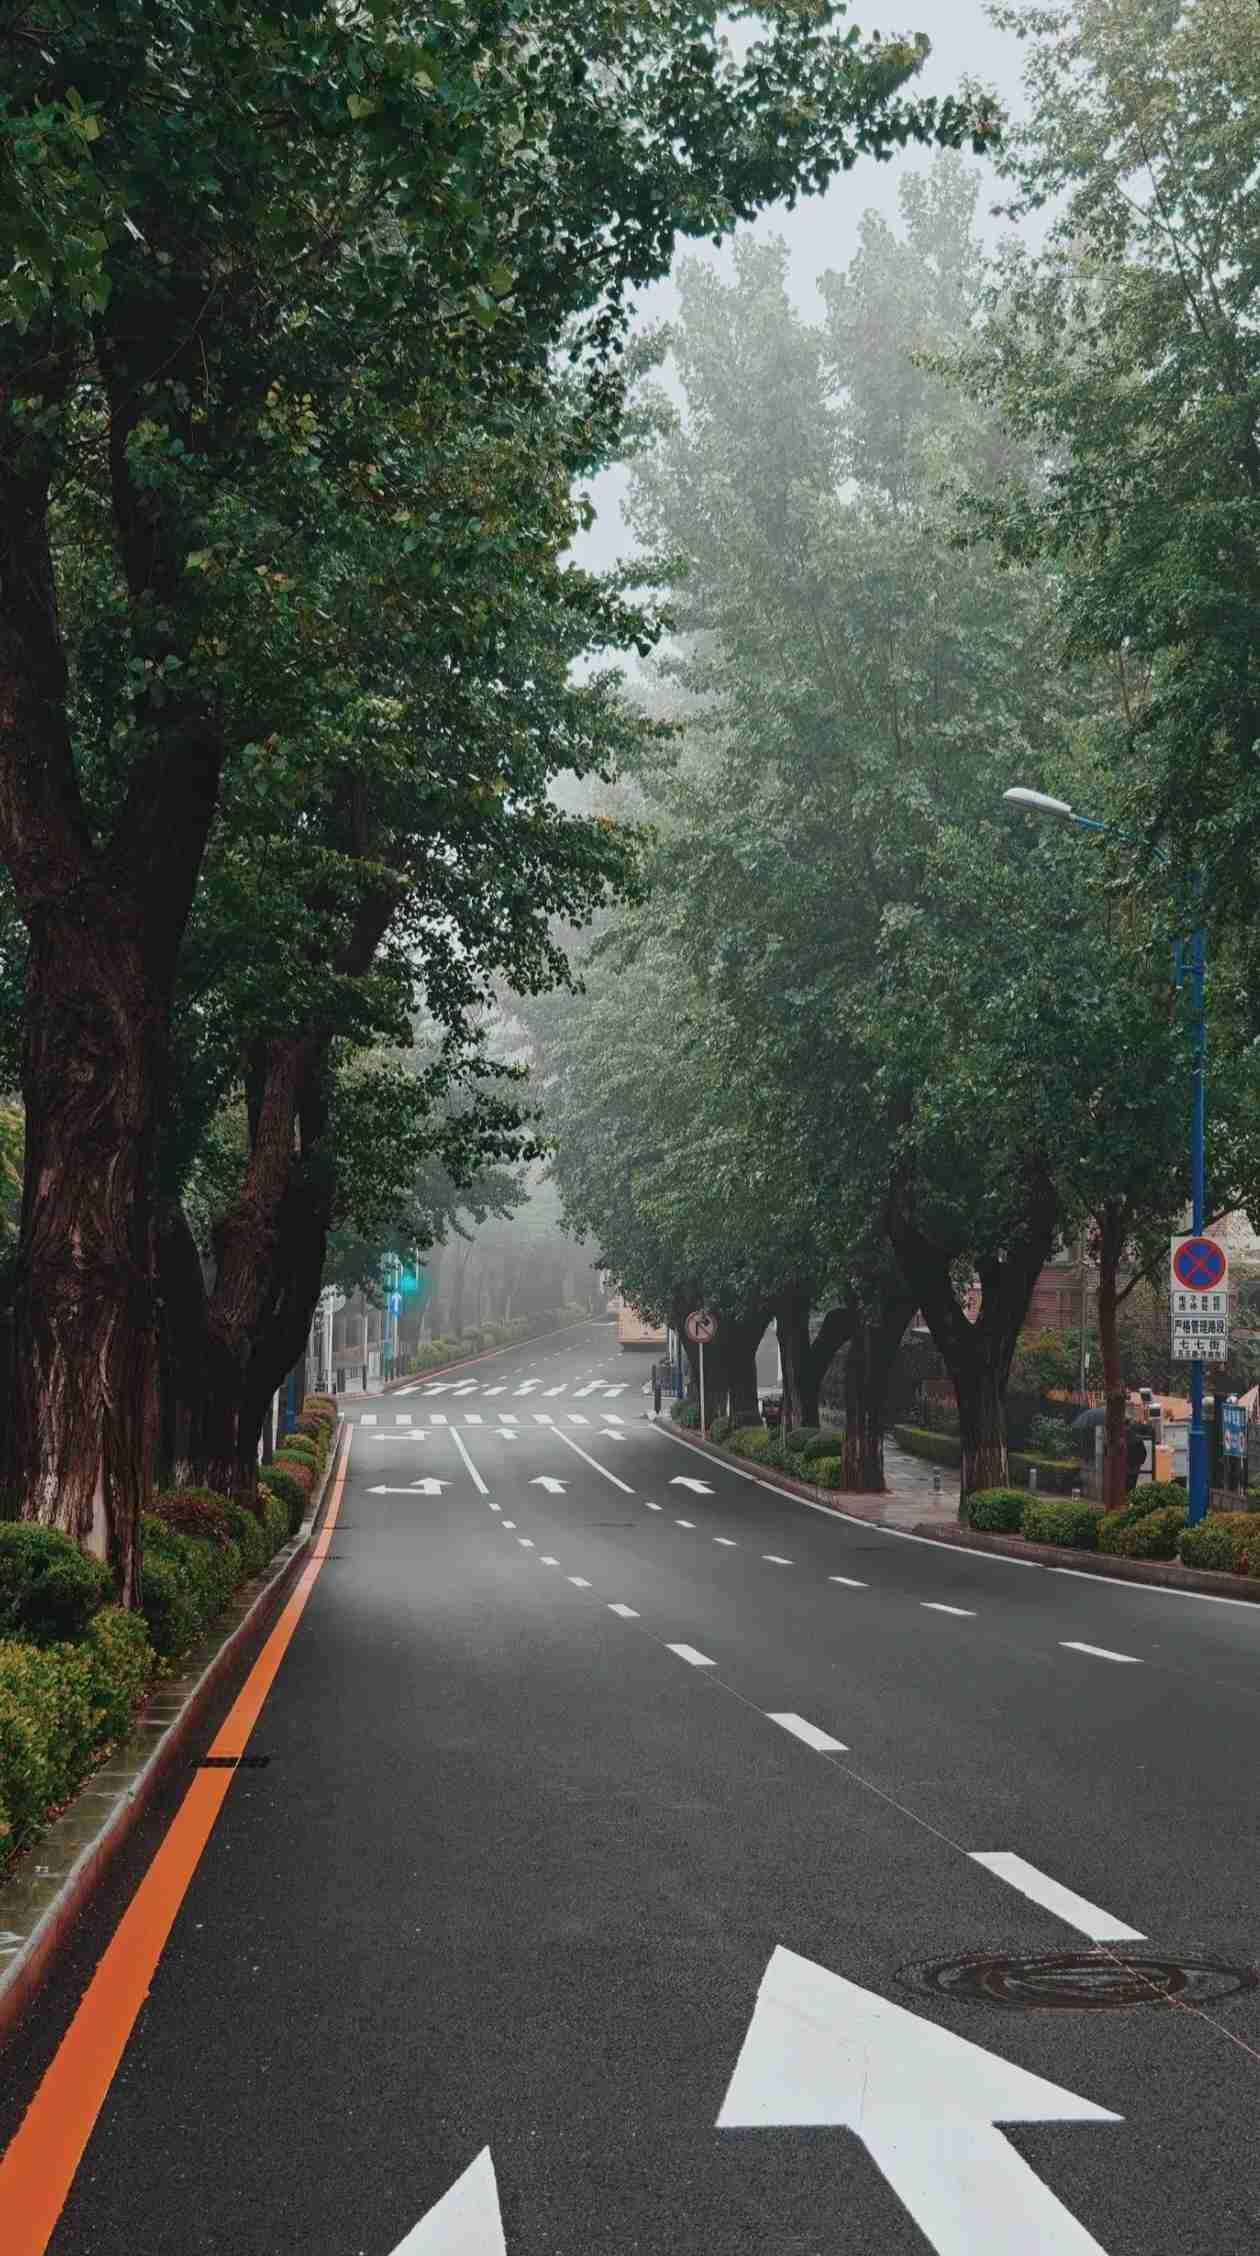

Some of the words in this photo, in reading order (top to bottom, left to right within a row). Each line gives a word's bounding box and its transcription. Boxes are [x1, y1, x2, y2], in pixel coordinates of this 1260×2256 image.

[1174, 1319, 1225, 1334] 严格管理路段
[1178, 1338, 1221, 1350] 七七街
